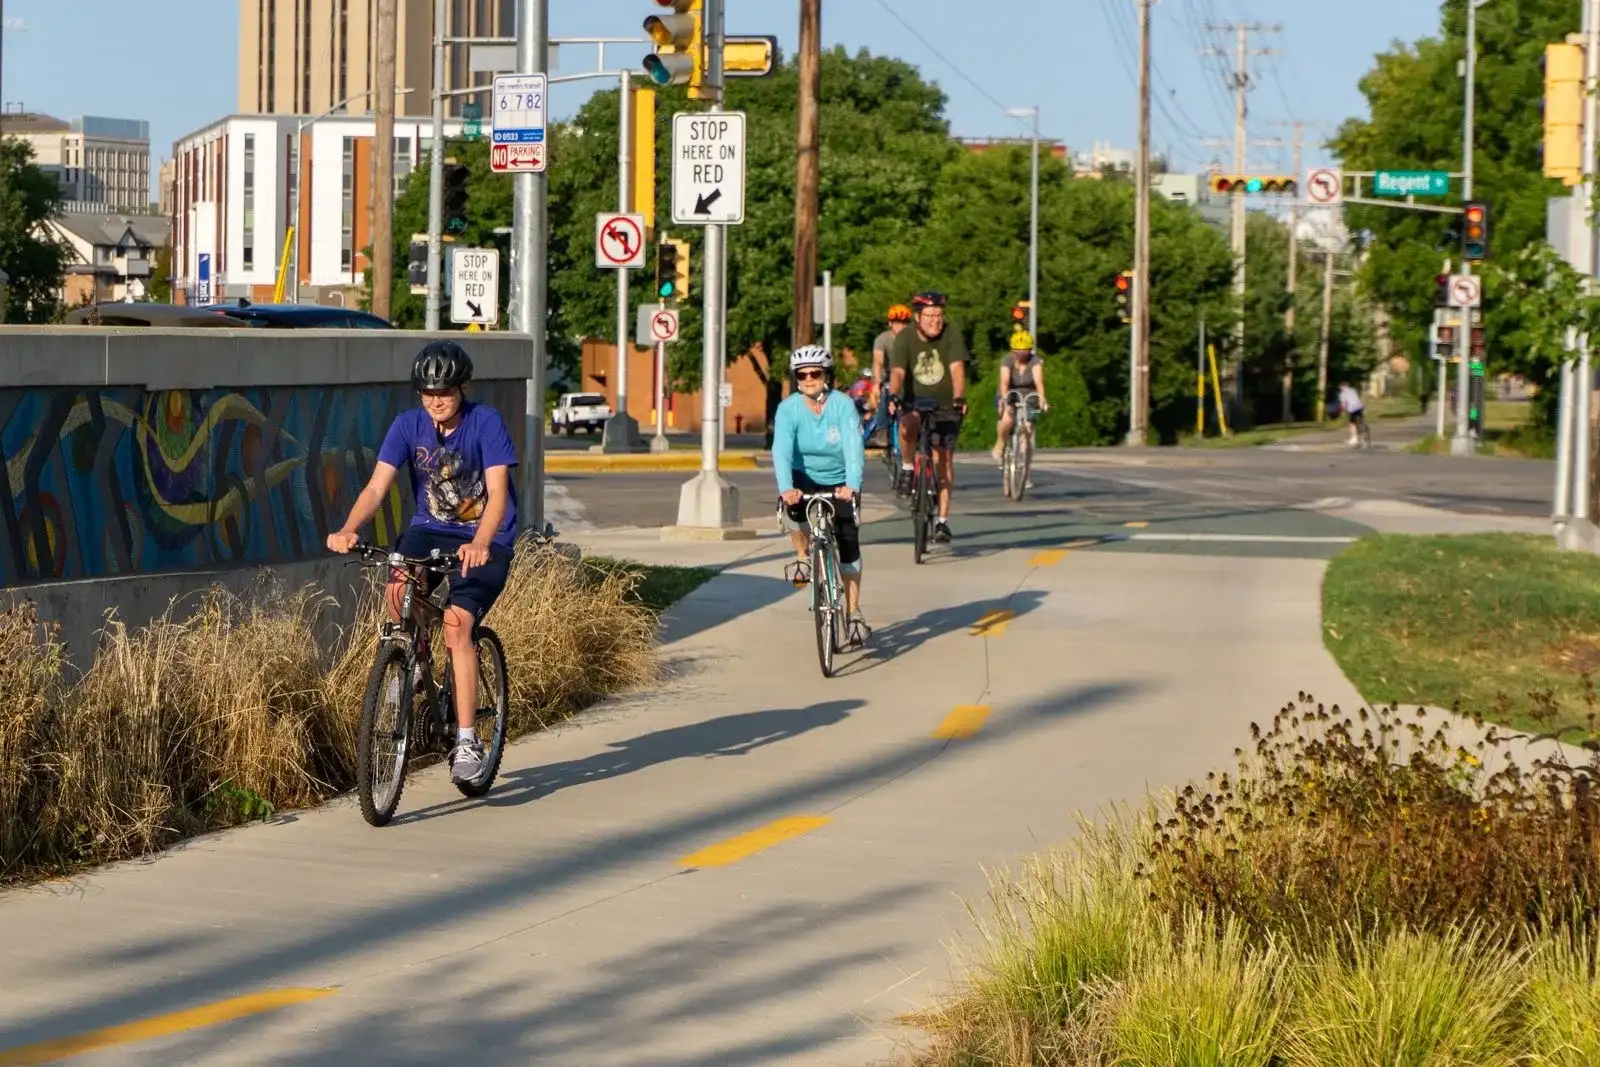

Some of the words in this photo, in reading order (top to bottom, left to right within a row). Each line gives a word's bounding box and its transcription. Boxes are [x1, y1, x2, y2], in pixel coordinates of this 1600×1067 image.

[501, 95, 508, 110] 6
[516, 94, 523, 109] 7
[527, 94, 541, 109] 82
[494, 133, 502, 141] ID
[690, 121, 728, 140] STOP
[493, 148, 507, 166] NO
[510, 146, 541, 157] PARKING
[682, 145, 713, 159] HERE
[720, 145, 736, 159] ON
[693, 164, 724, 183] RED
[1379, 172, 1430, 195] Regent
[463, 255, 488, 268] STOP
[458, 270, 477, 281] HERE
[482, 271, 493, 281] ON
[465, 283, 485, 297] RED
